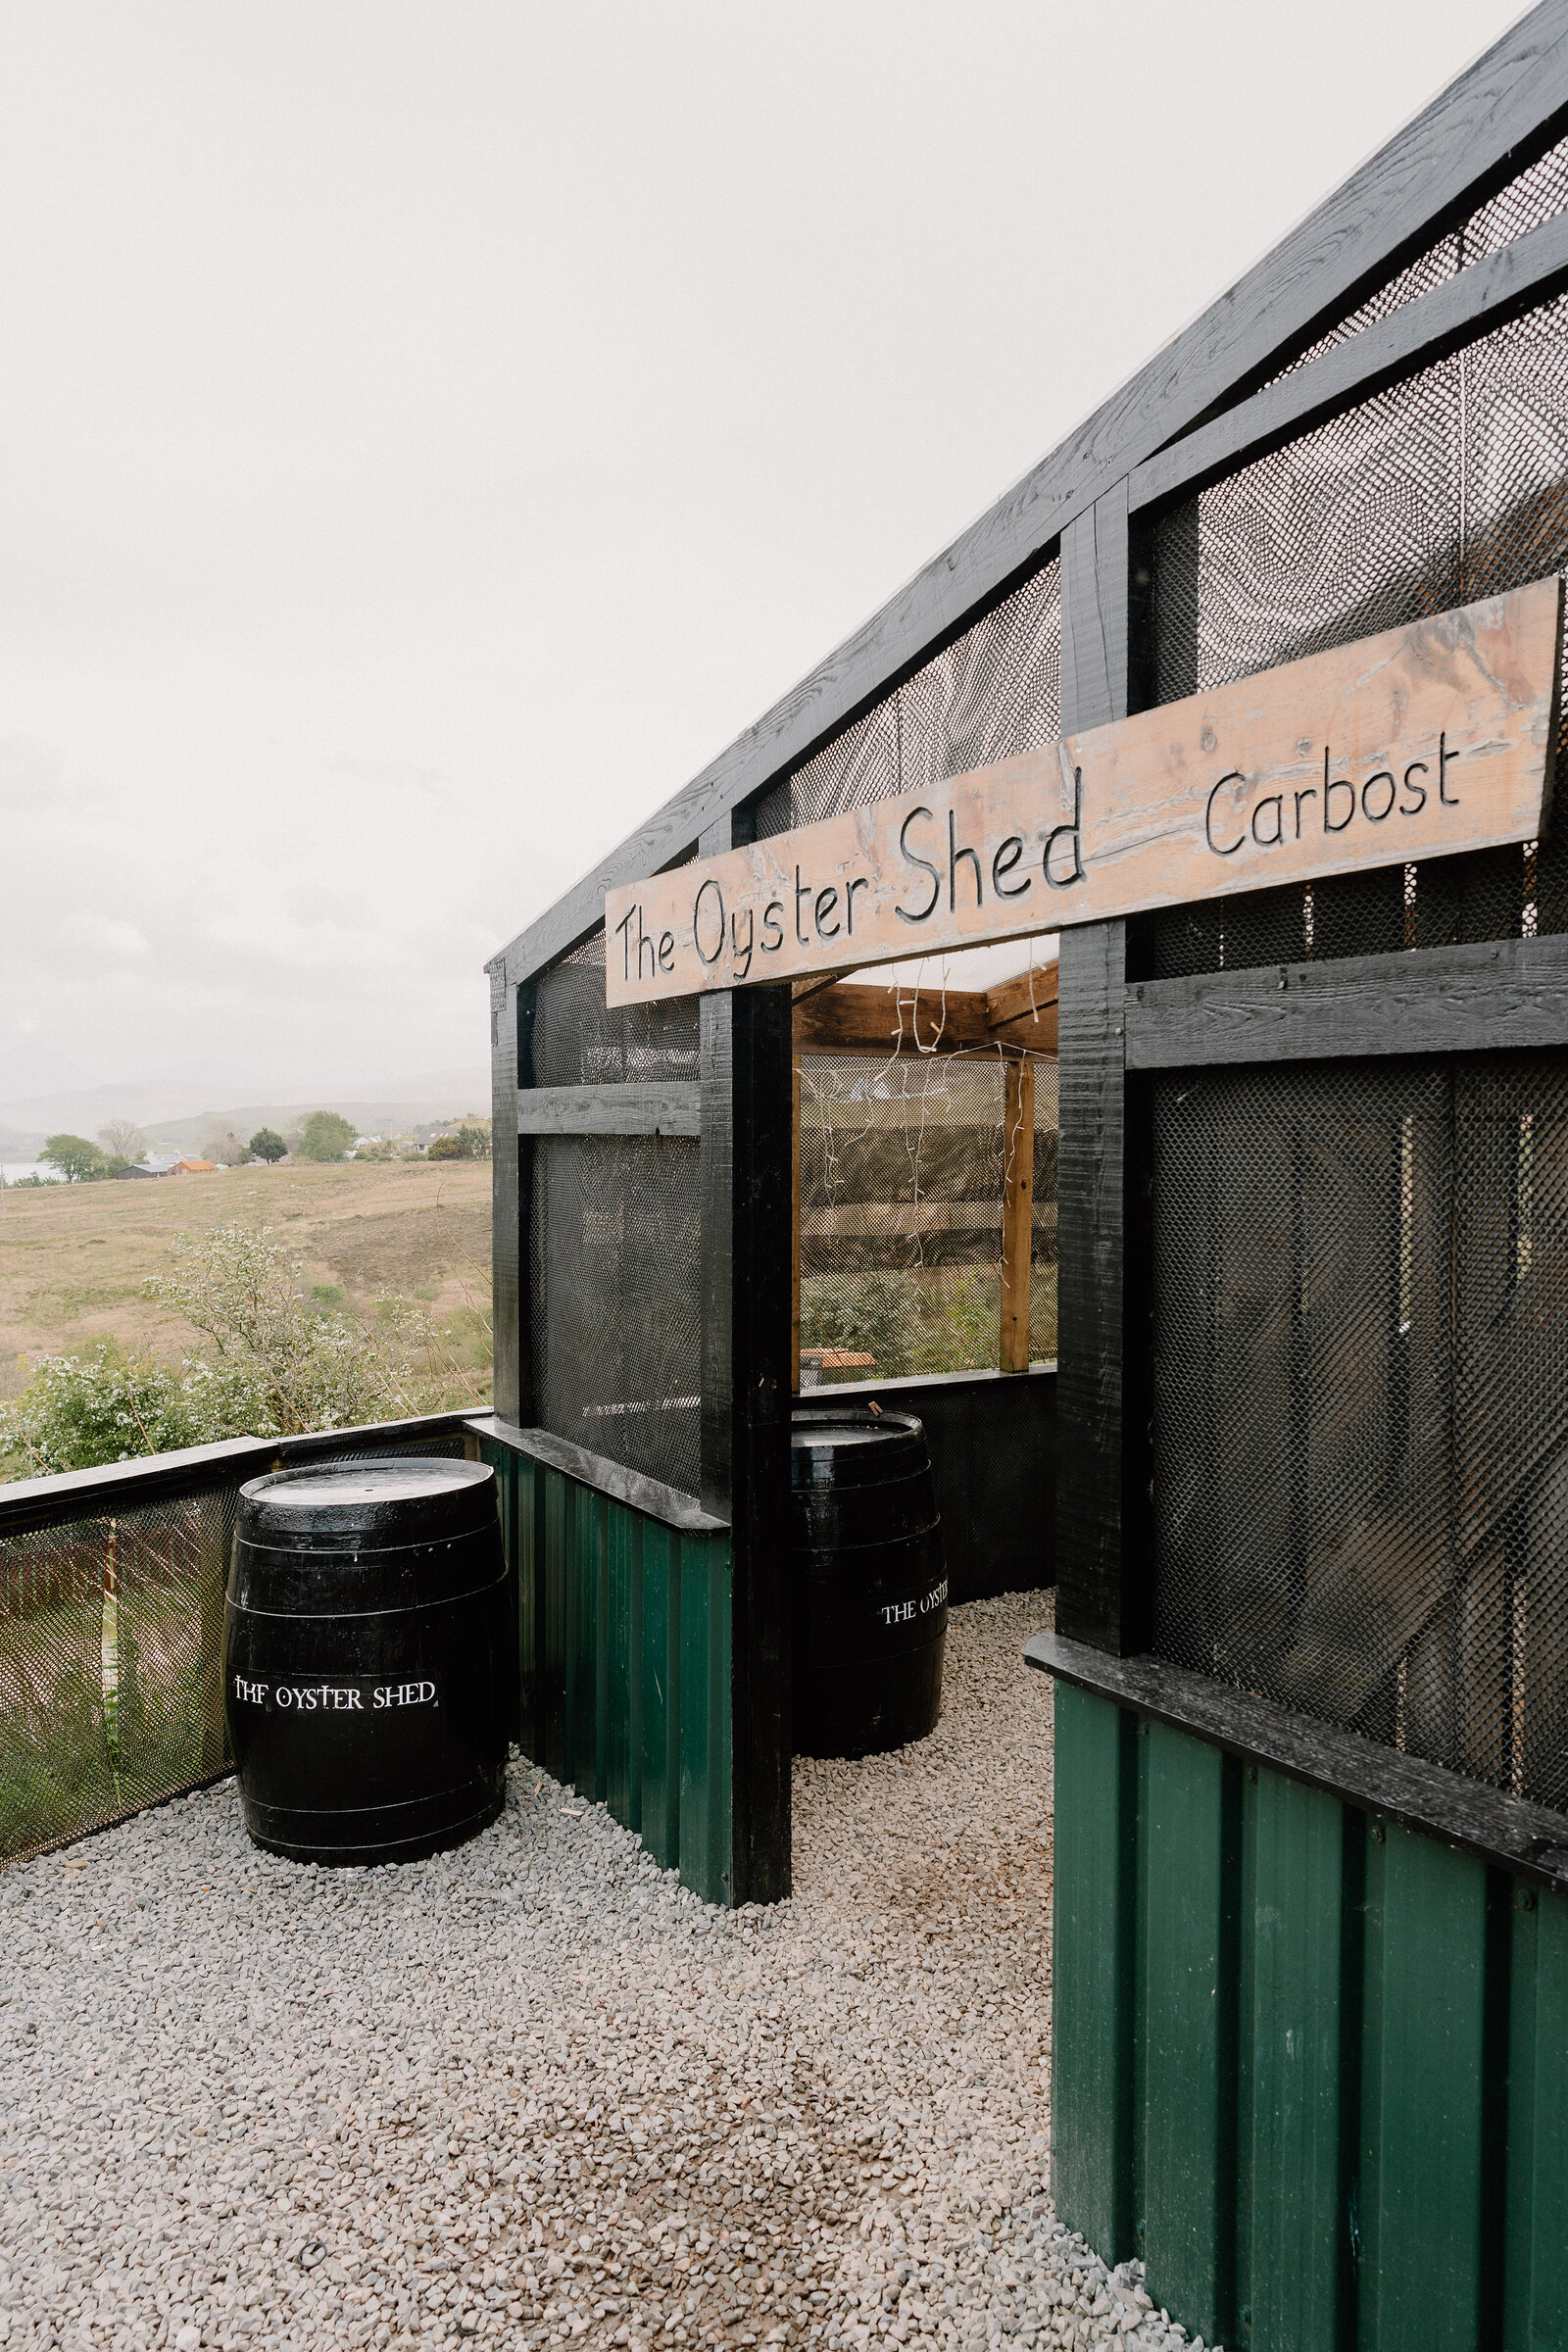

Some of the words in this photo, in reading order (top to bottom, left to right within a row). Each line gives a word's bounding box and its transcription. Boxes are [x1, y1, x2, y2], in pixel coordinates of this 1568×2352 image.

[616, 904, 675, 981] The
[693, 865, 870, 981] Oyster
[896, 766, 1087, 924] Shed
[1205, 731, 1461, 855] Carbost
[882, 1600, 916, 1625] THE
[275, 1685, 364, 1709] OYSTER
[372, 1681, 436, 1709] SHED
